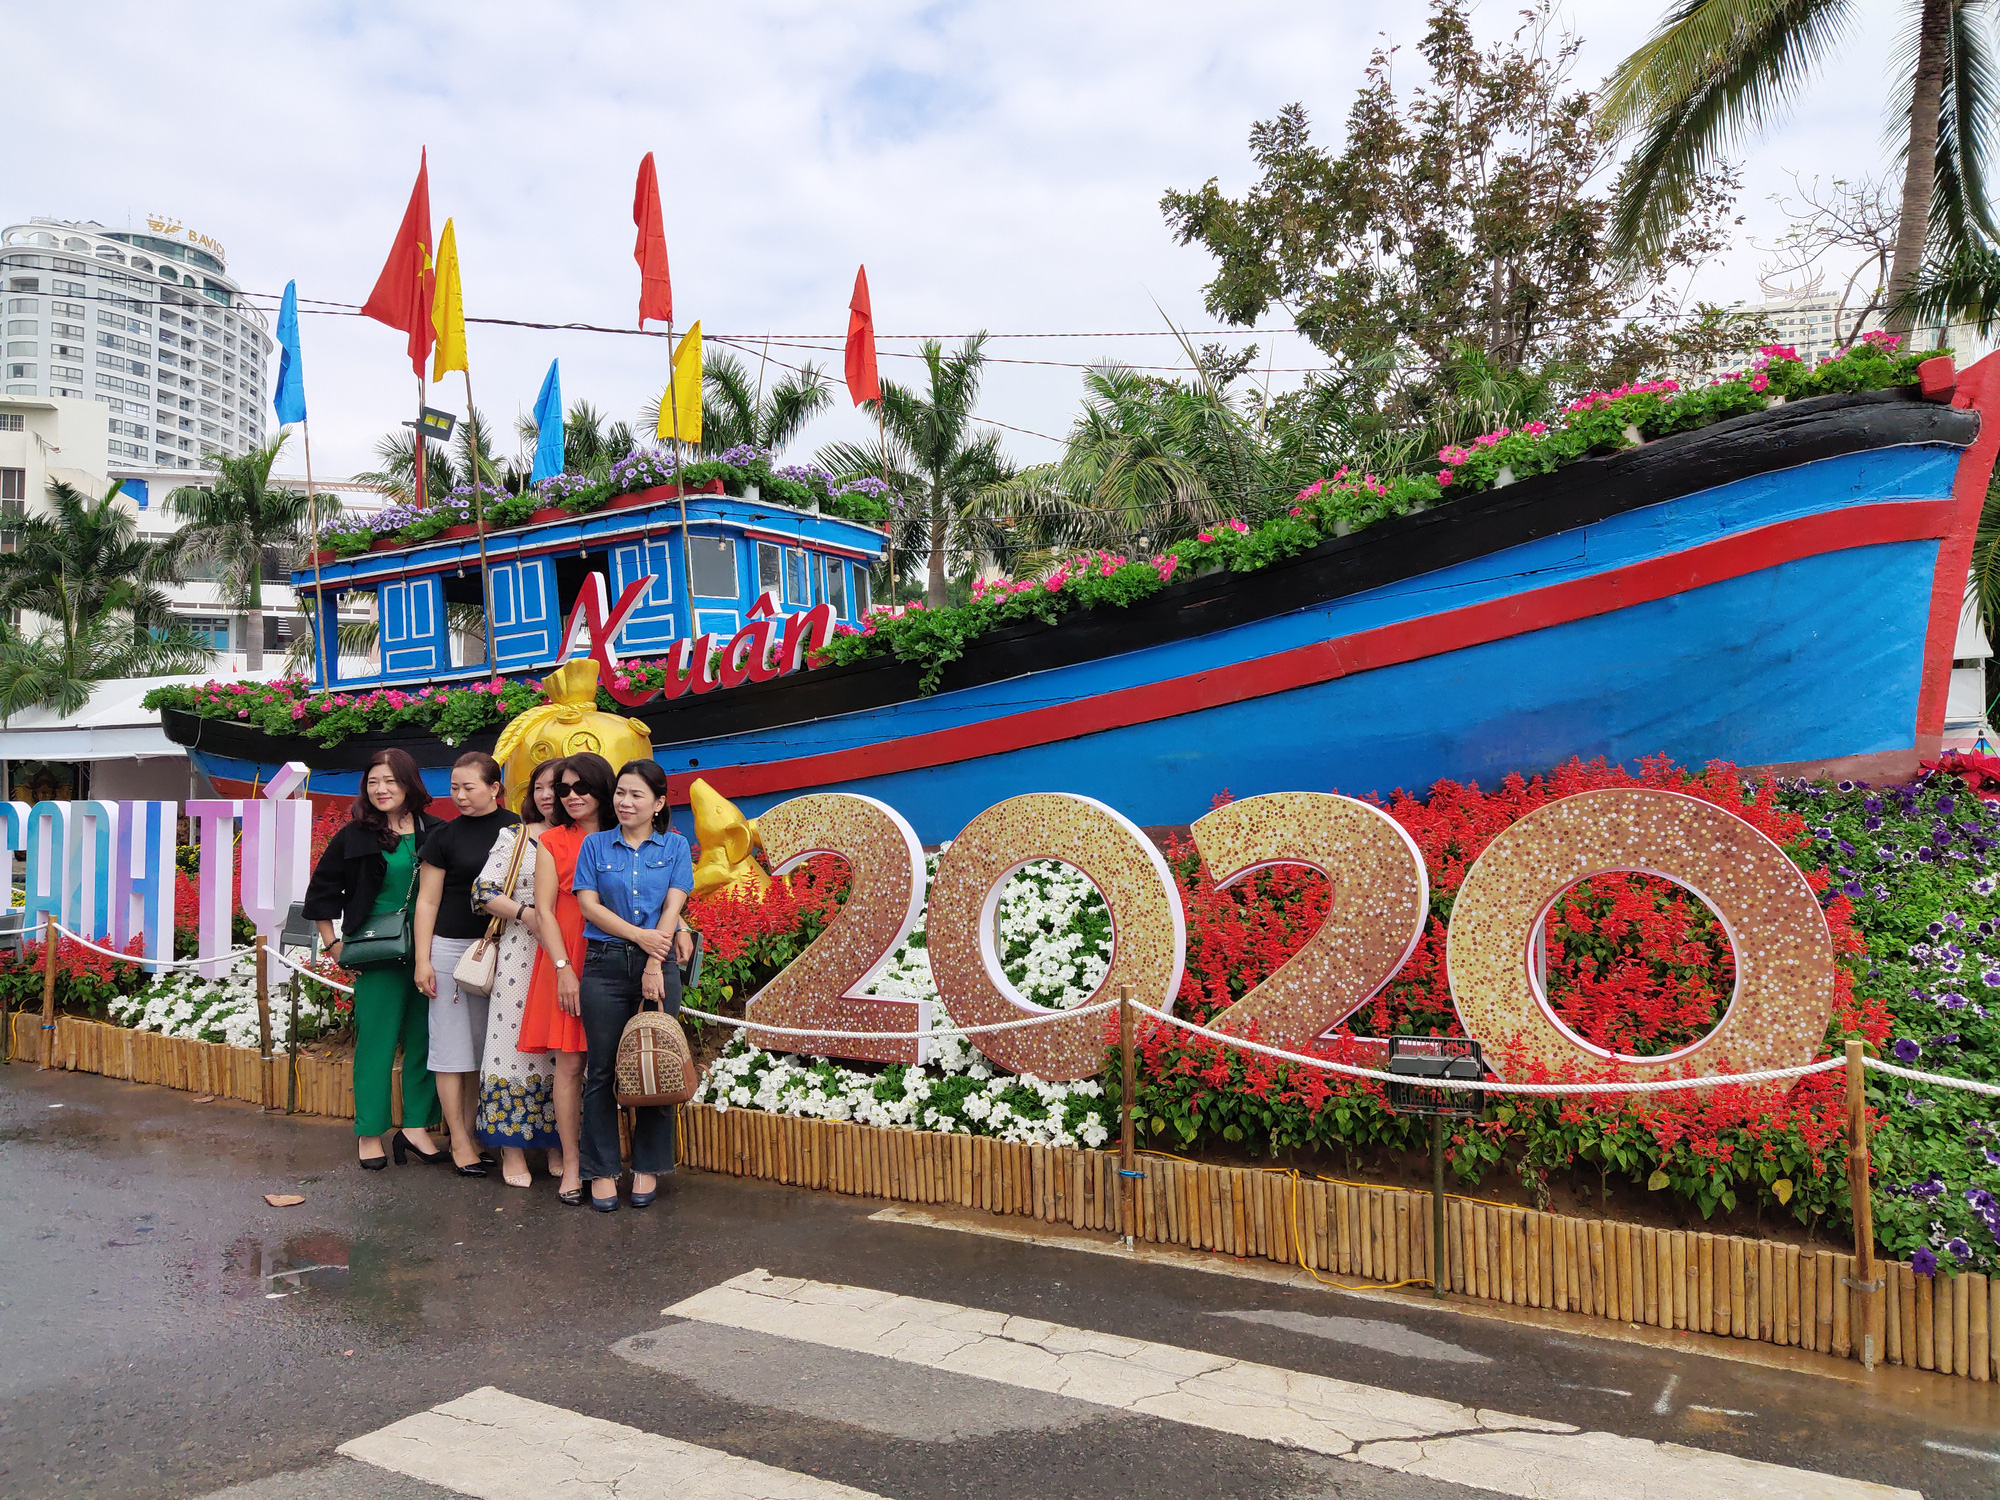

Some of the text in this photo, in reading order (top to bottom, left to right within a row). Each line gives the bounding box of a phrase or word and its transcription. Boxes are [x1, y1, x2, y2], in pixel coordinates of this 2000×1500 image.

[555, 571, 837, 706] Xuân
[186, 762, 312, 984] TÝ
[745, 788, 1834, 1092] 2020
